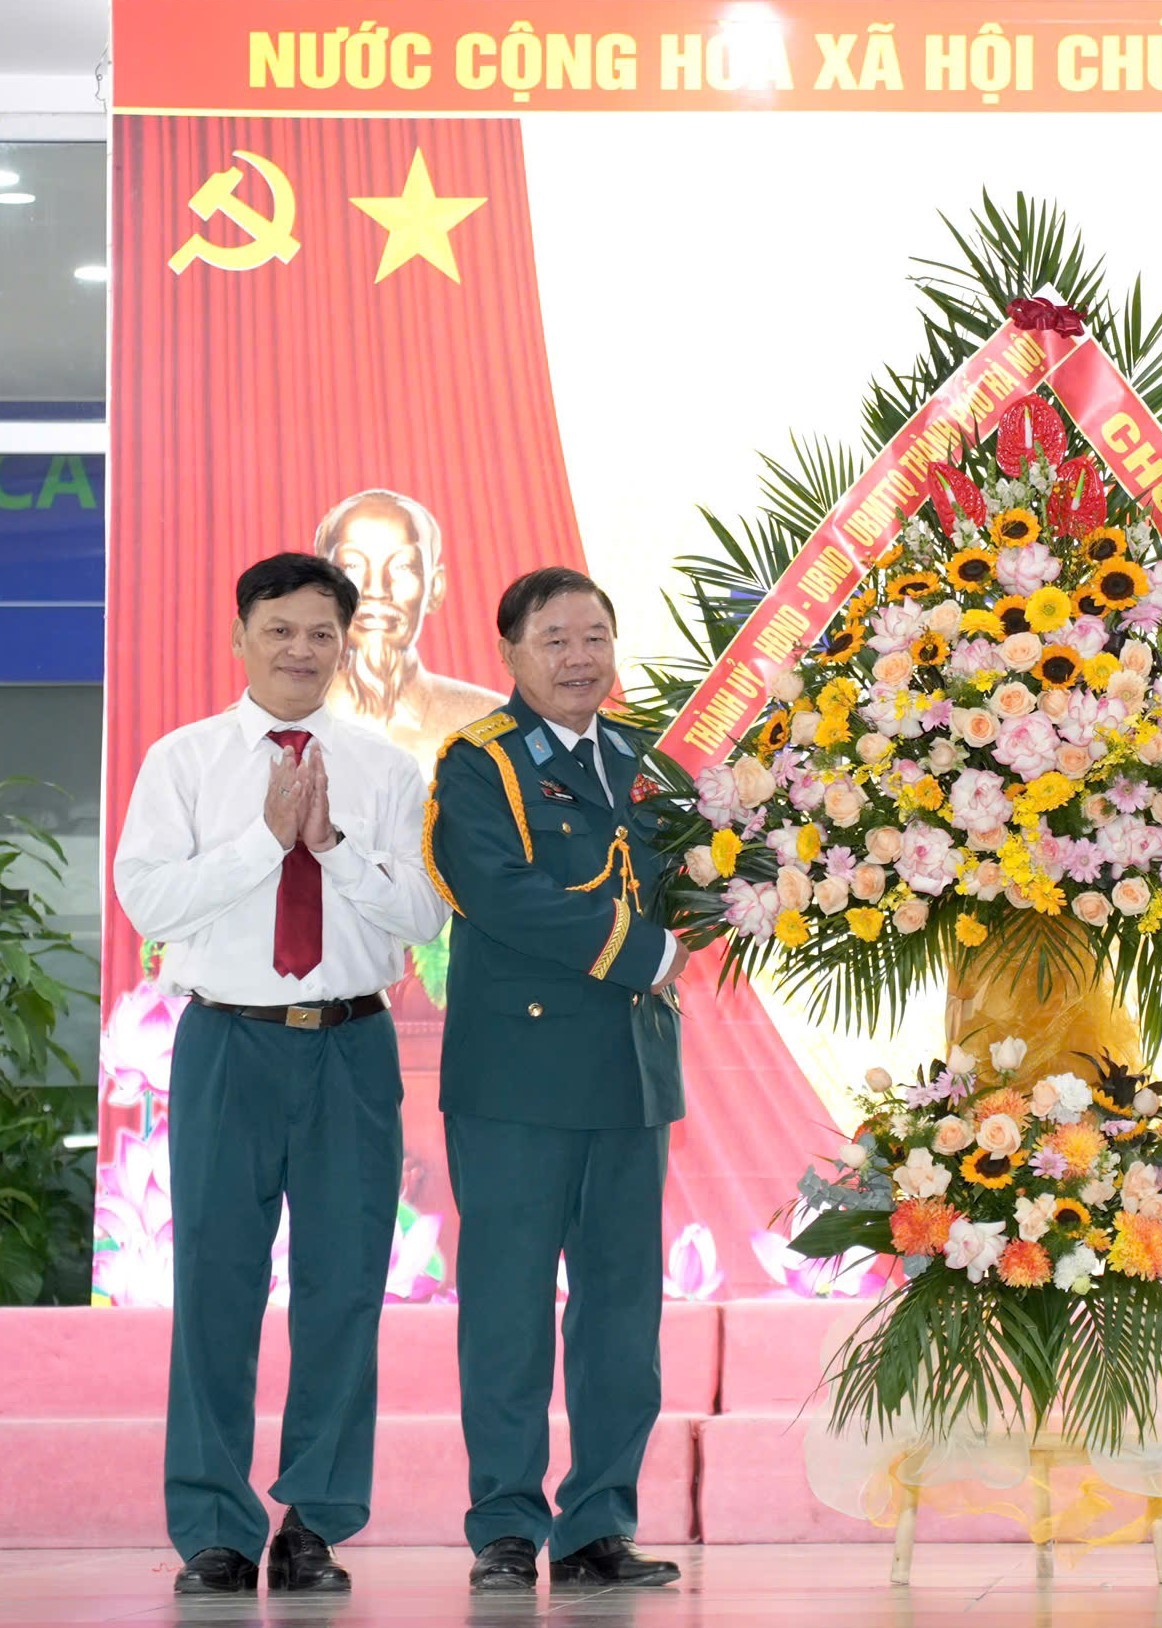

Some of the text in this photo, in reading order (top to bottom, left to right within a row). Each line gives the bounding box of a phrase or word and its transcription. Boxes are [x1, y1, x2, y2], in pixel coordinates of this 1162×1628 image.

[249, 21, 432, 90] NƯỚC
[455, 20, 636, 102] CỘNG
[813, 23, 903, 91] XÃ
[925, 22, 1033, 104] HỘI
[683, 687, 748, 756] THÀNH
[797, 545, 854, 603] UBND
[843, 469, 919, 547] UBMTTQ
[899, 415, 962, 483] THÀNH
[980, 357, 1021, 401] HÀ
[1001, 331, 1047, 378] NỘI
